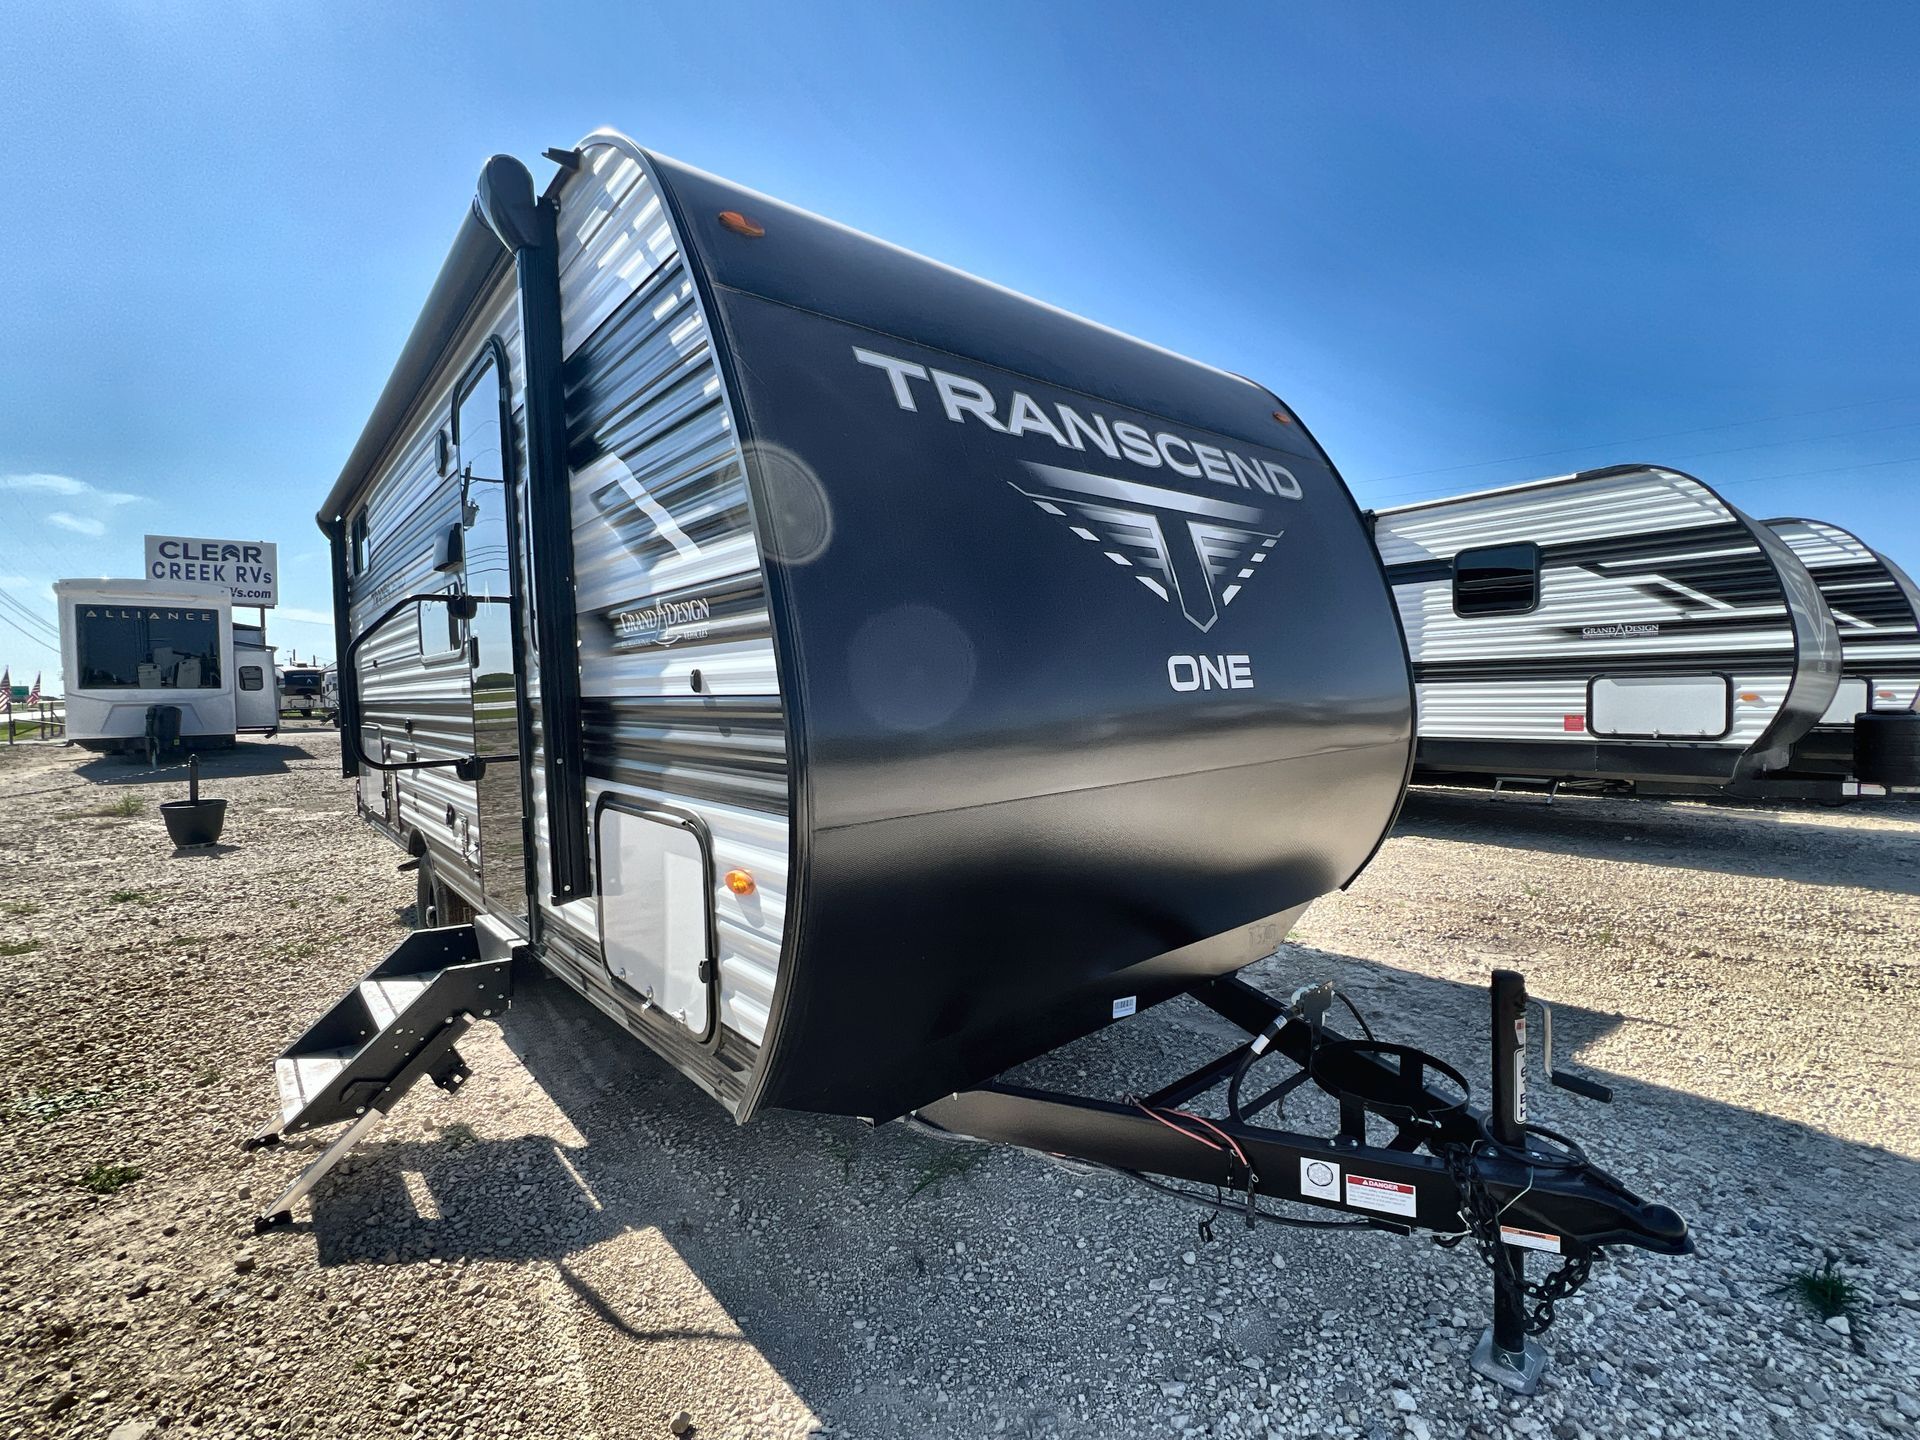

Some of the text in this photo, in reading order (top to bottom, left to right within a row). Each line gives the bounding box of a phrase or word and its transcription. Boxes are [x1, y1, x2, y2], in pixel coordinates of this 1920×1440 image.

[852, 345, 1303, 501] TRANSCEND
[158, 541, 263, 564] CLEAR
[152, 561, 272, 584] CREEK RVs
[230, 587, 271, 599] Vs.com
[86, 610, 212, 621] ALLIANCE
[664, 598, 710, 625] DESIGN
[1625, 624, 1659, 632] DESIGN
[1167, 654, 1255, 692] ONE
[1368, 1180, 1399, 1192] DANGER
